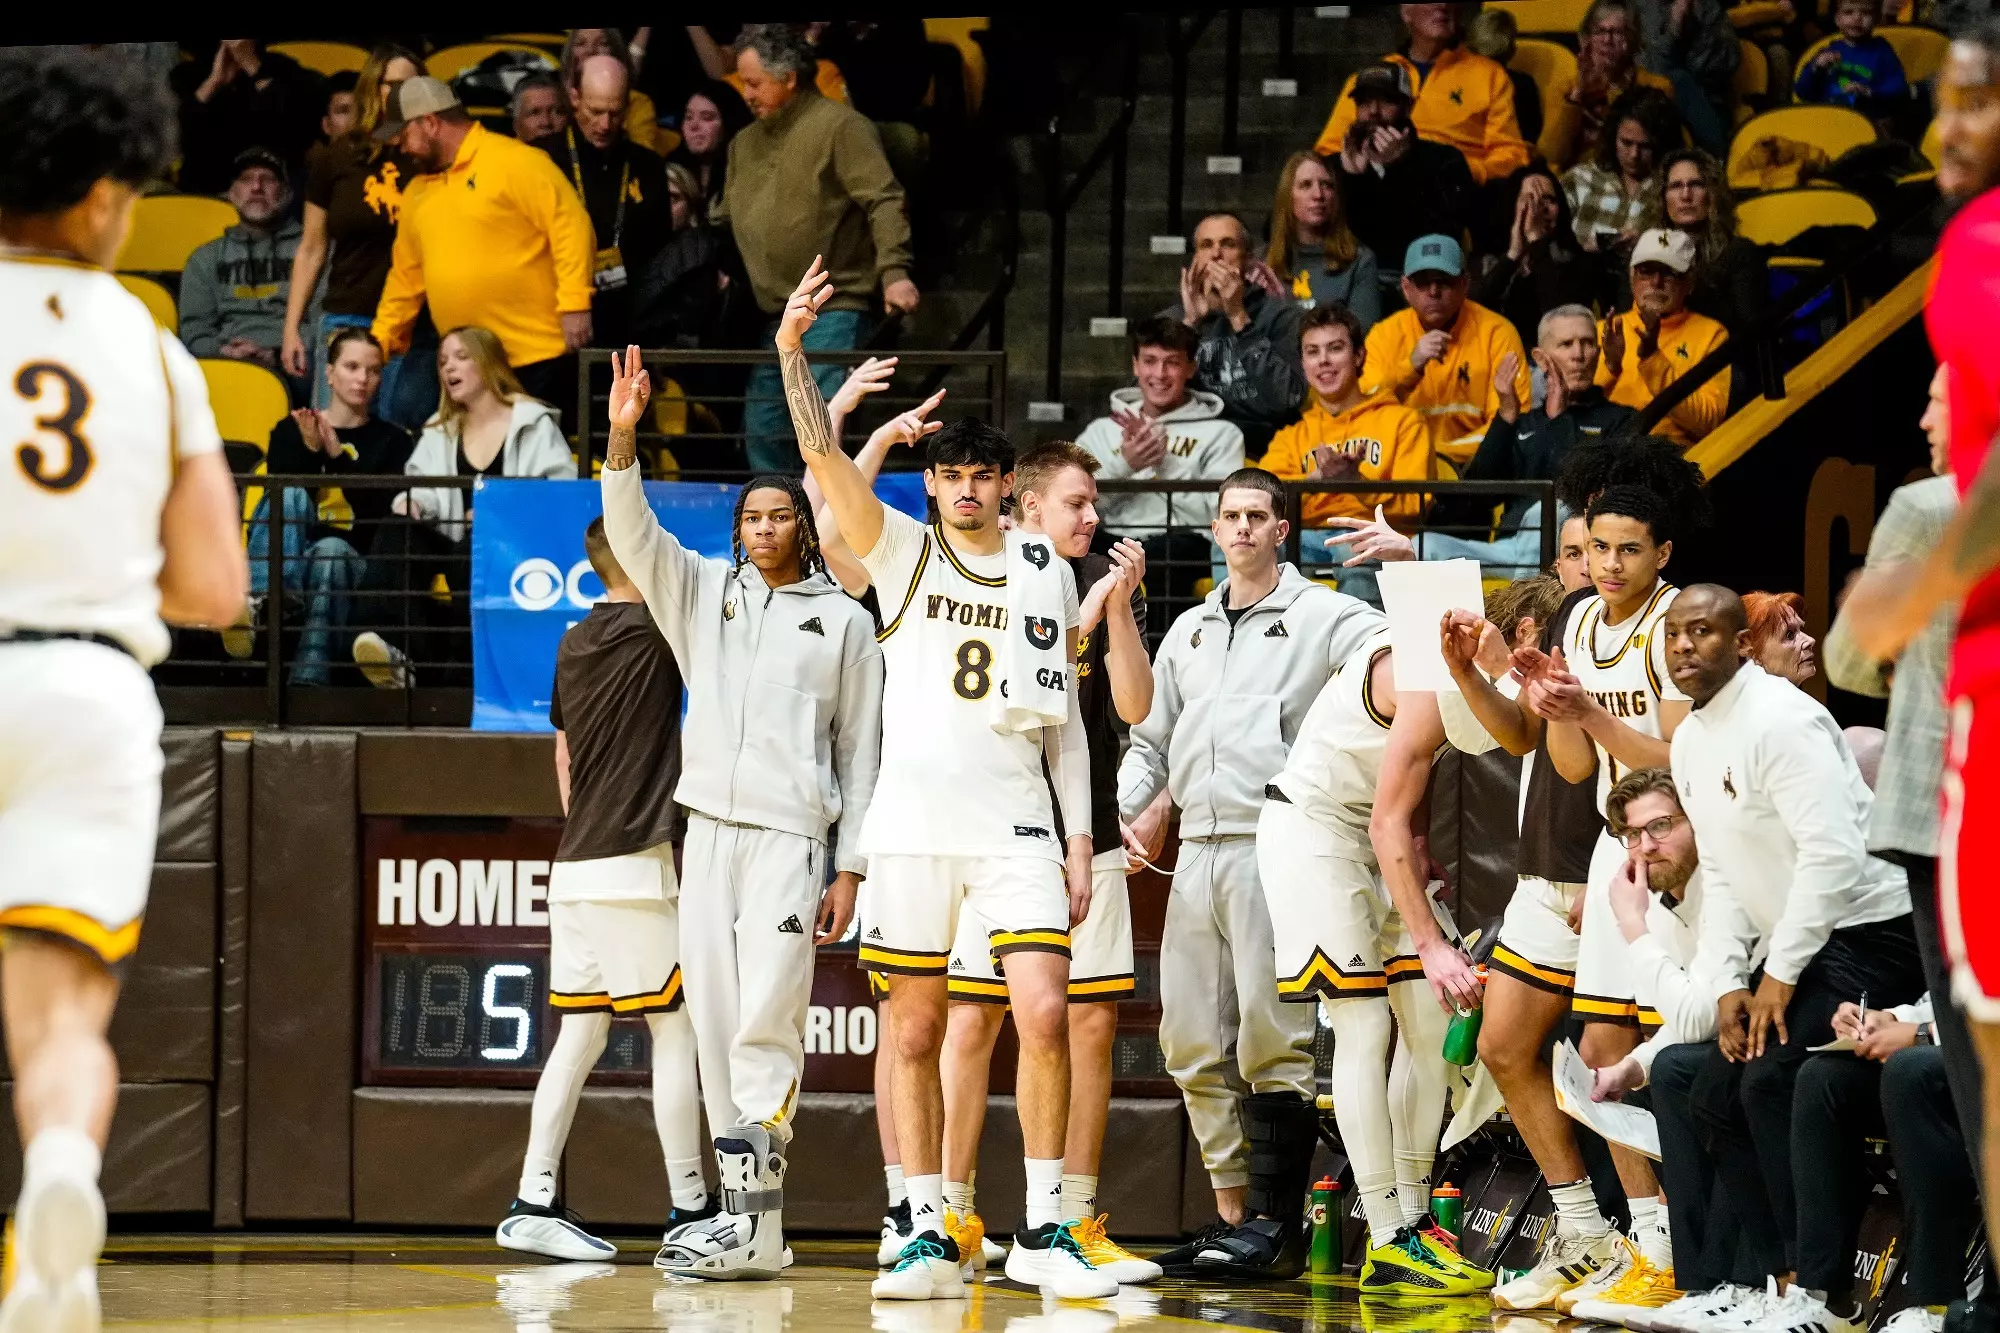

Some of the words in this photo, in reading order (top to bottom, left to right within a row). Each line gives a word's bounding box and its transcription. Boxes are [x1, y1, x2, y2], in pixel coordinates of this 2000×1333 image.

[13, 360, 96, 494] 3
[926, 594, 1009, 631] WYOMI
[953, 639, 994, 700] 8
[1036, 667, 1068, 692] GA
[378, 858, 549, 926] HOME
